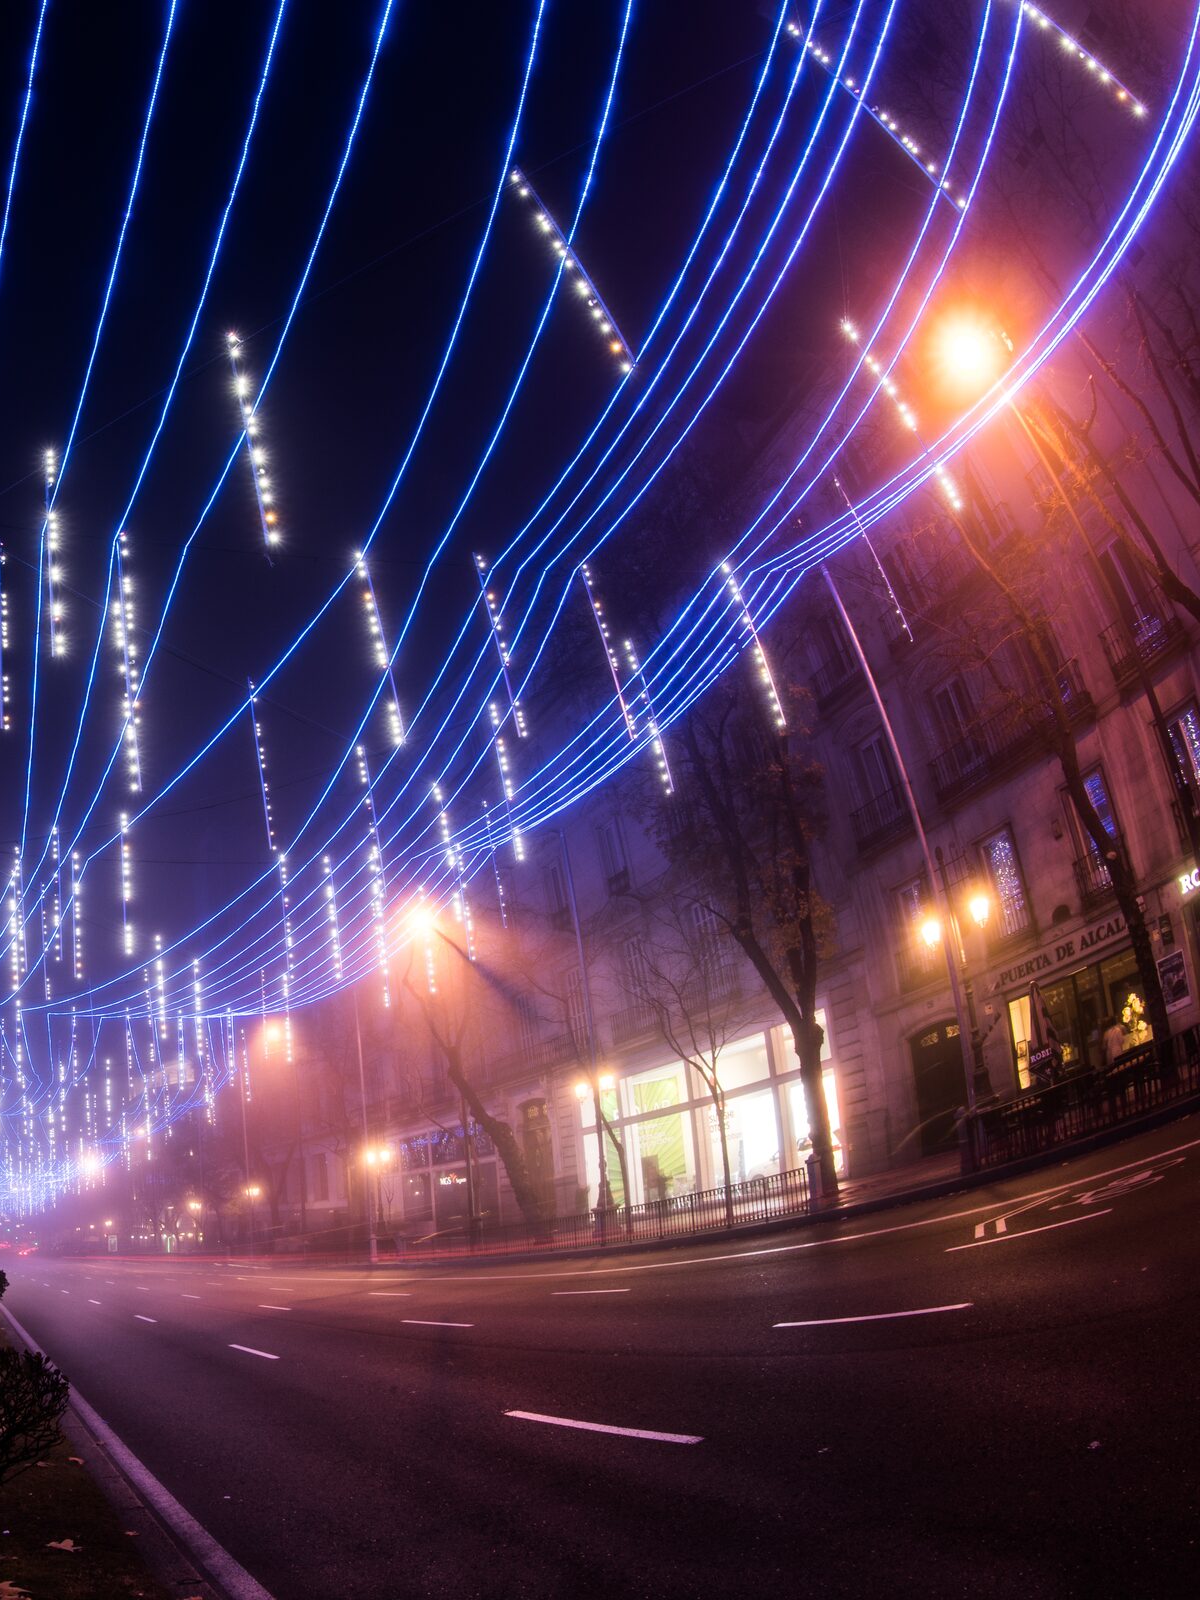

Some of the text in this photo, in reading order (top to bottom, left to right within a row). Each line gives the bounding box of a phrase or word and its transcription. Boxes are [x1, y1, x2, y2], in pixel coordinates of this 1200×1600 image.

[1000, 917, 1128, 986] PUERTA DE ALCAL
